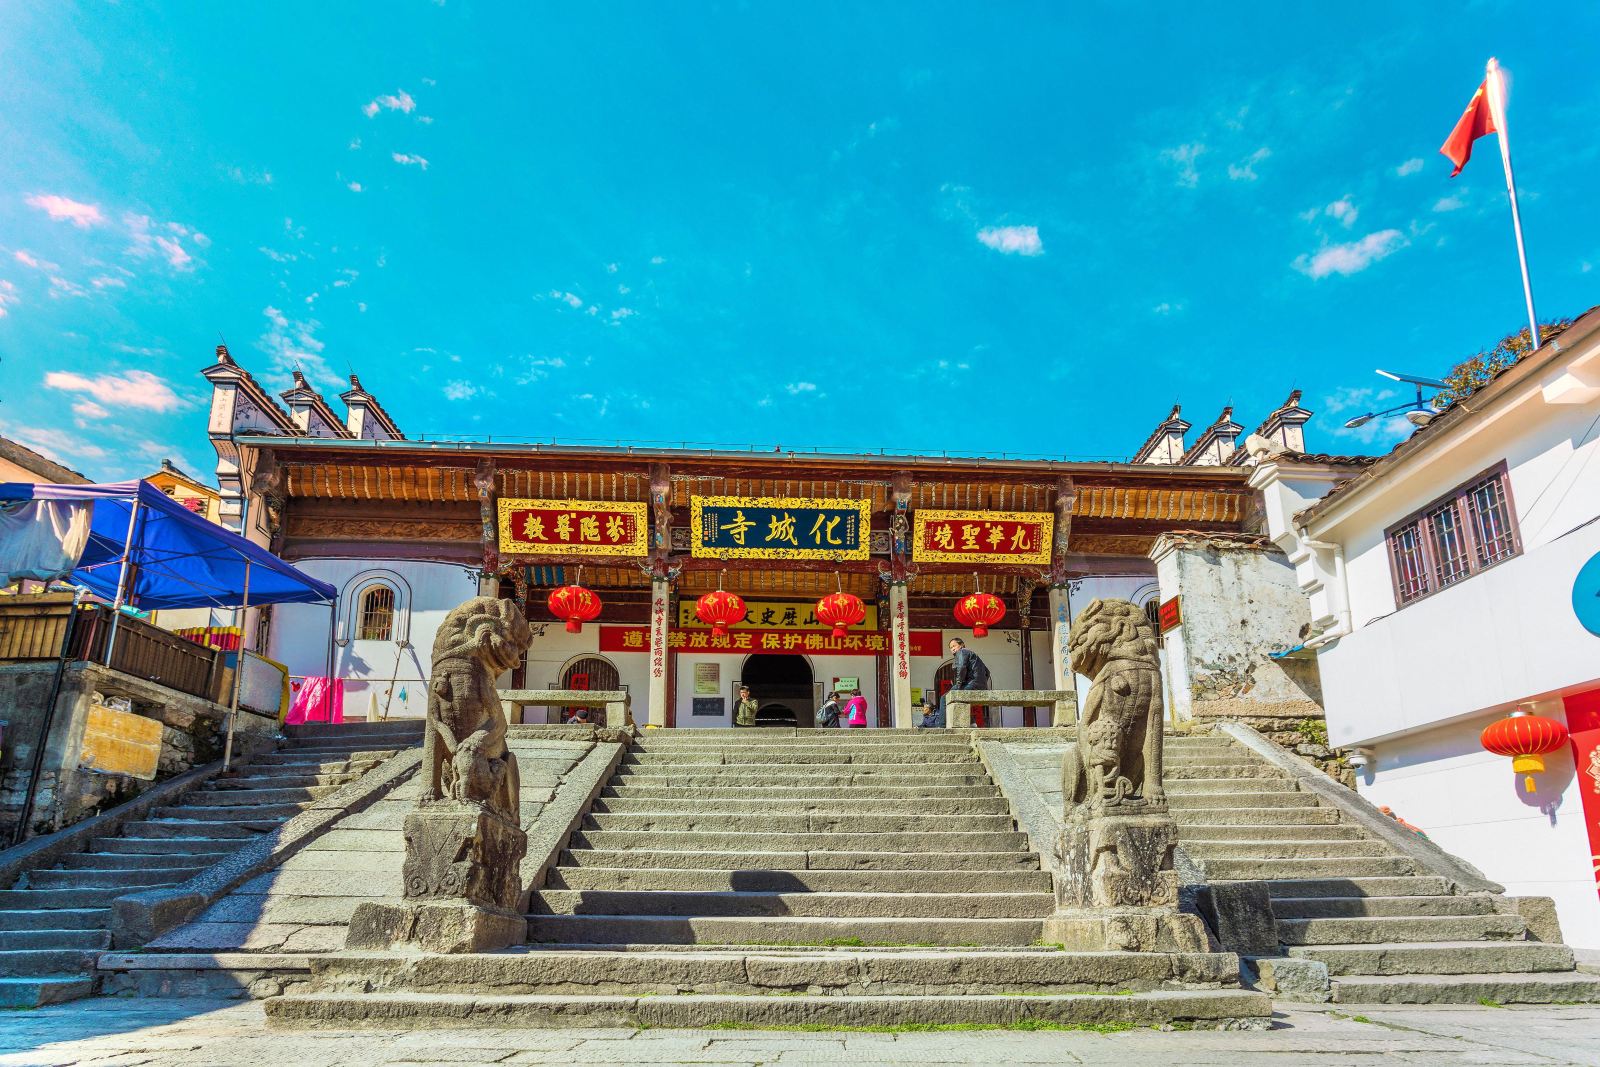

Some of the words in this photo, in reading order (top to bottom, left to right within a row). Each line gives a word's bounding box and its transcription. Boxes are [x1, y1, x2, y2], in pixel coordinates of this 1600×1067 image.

[720, 510, 843, 546] 化城寺
[934, 523, 1031, 551] 九華聖境
